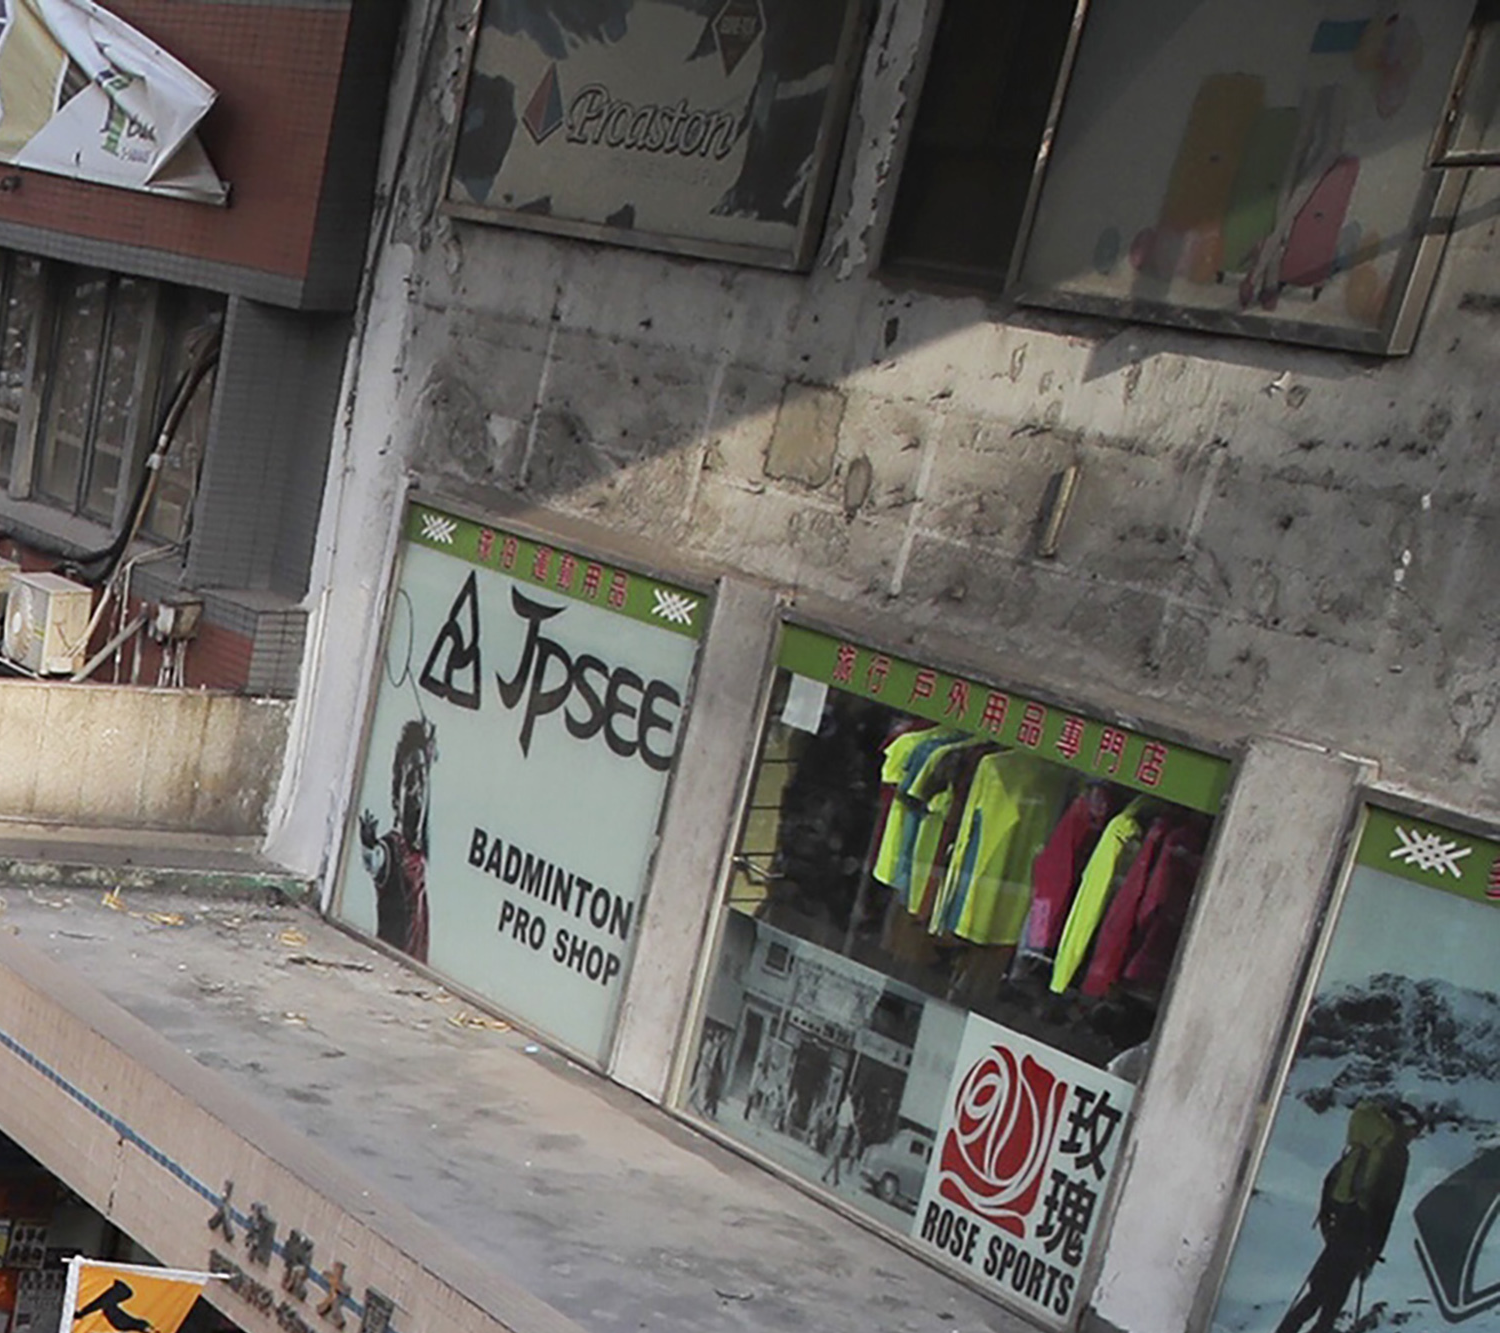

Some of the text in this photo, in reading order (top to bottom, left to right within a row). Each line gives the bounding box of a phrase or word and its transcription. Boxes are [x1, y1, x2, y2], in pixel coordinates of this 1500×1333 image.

[832, 644, 1168, 788] 旅行戶外用品專門店
[468, 827, 635, 942] BADMINTON
[498, 899, 621, 988] PRO SHOP
[1034, 1081, 1122, 1269] 玫瑰
[920, 1201, 1076, 1316] ROSE SPORTS
